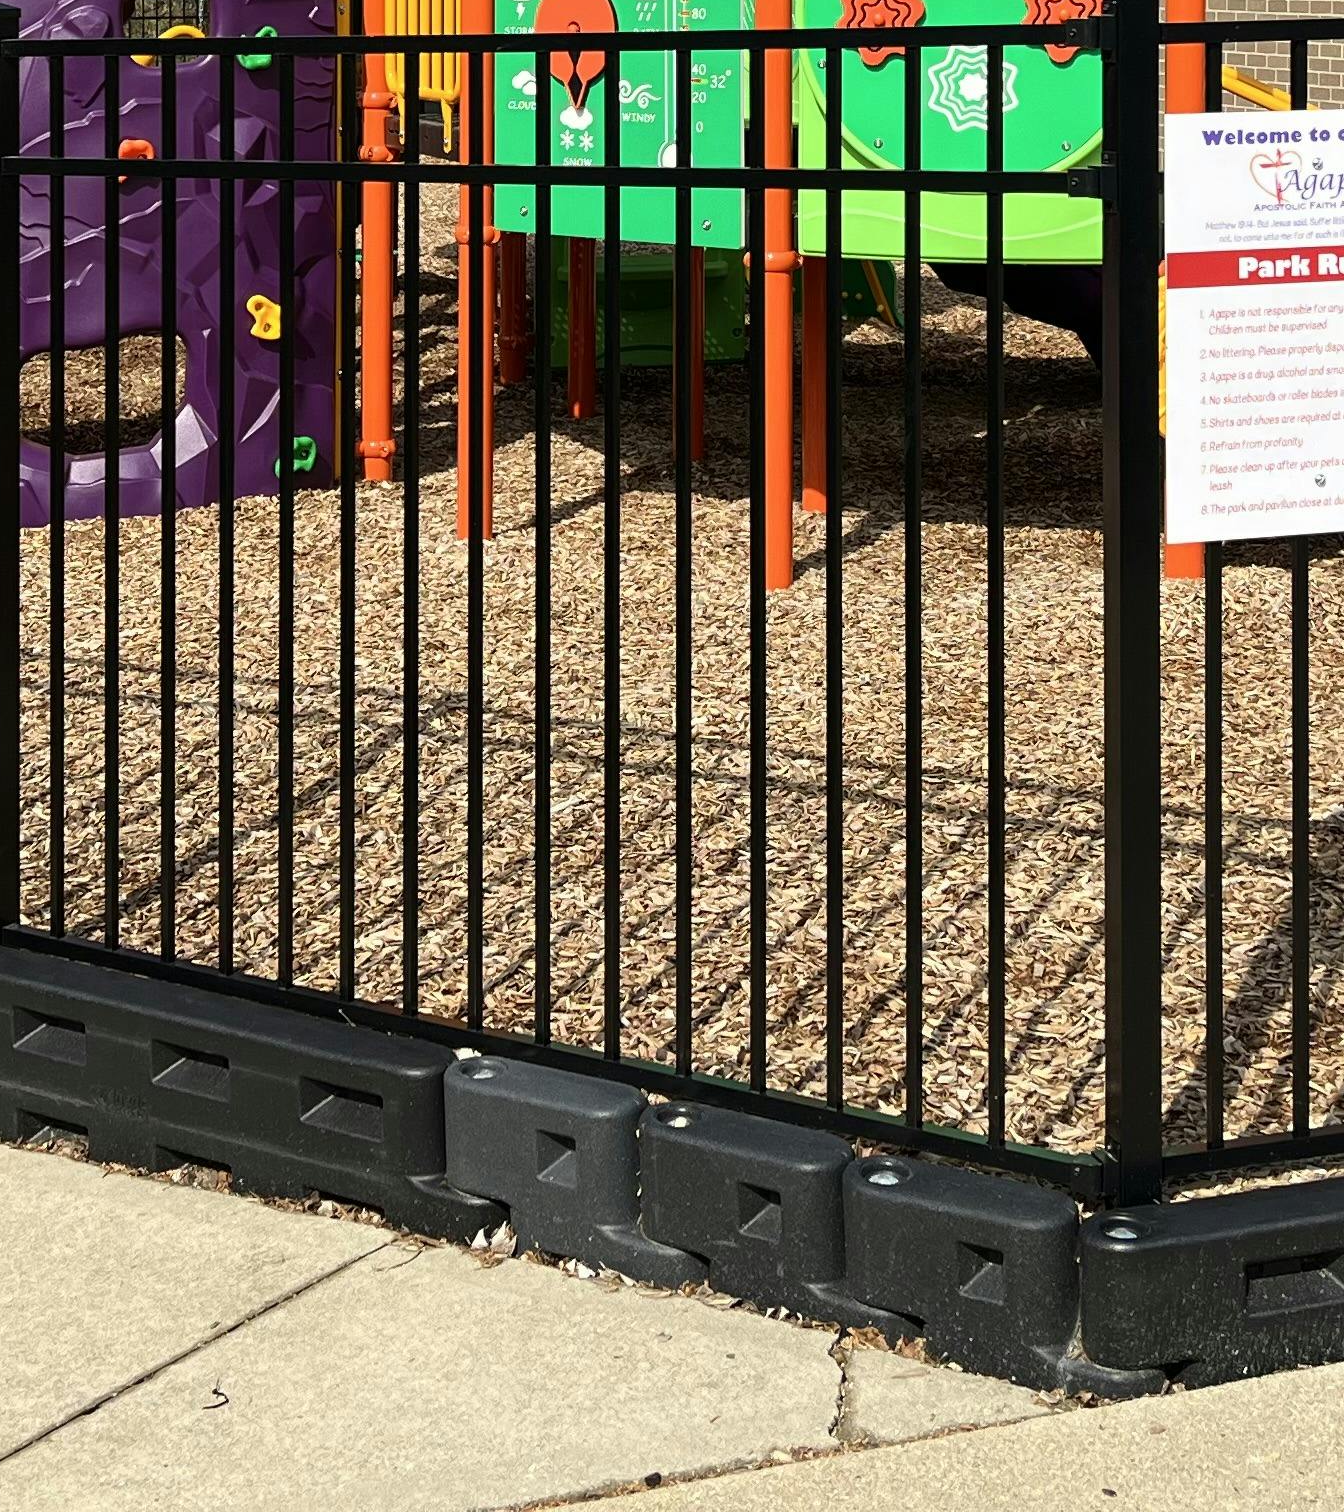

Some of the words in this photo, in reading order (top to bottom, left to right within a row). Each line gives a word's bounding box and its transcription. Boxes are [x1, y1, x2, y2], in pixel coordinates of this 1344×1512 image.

[691, 7, 707, 20] 80
[691, 91, 707, 104] 20
[621, 112, 656, 124] WINDY
[695, 120, 704, 133] 0
[1202, 128, 1302, 146] Welcome
[1310, 127, 1331, 142] to
[562, 157, 593, 166] SNOW
[1254, 201, 1306, 212] APOSTOLIC
[1309, 200, 1337, 210] FAITH
[1238, 254, 1310, 279] Park
[1209, 308, 1237, 321] Agape
[1247, 306, 1262, 317] not
[1264, 303, 1312, 318] responsible
[1313, 303, 1326, 313] for
[1328, 304, 1344, 314] any
[1209, 322, 1244, 336] Children
[1245, 323, 1266, 334] must
[1268, 322, 1280, 333] be
[1199, 349, 1208, 360] 2.
[1209, 348, 1221, 359] No
[1258, 345, 1287, 356] Please
[1288, 342, 1323, 357] properly
[1199, 372, 1208, 382] 3.
[1209, 370, 1237, 384] Agape
[1277, 366, 1307, 378] alcohol
[1309, 365, 1325, 376] and
[1209, 395, 1221, 405] No
[1223, 391, 1276, 405] skateboards
[1287, 389, 1310, 401] roller
[1311, 387, 1338, 399] blades
[1209, 417, 1235, 428] Shirts
[1236, 416, 1252, 427] and
[1254, 414, 1280, 425] shoes
[1281, 414, 1295, 424] are
[1297, 410, 1331, 425] required
[1332, 411, 1341, 421] at
[1209, 440, 1241, 452] Refrain
[1242, 439, 1263, 450] from
[1264, 436, 1304, 450] profanity
[1210, 463, 1239, 475] Please
[1240, 462, 1263, 472] clean
[1264, 462, 1276, 473] up
[1276, 460, 1299, 470] after
[1300, 459, 1320, 471] your
[1320, 458, 1340, 470] pets
[1209, 481, 1233, 492] leash
[1210, 503, 1226, 514] The
[1227, 501, 1247, 517] park
[1248, 500, 1265, 512] and
[1265, 497, 1298, 513] pavilion
[1299, 497, 1322, 509] close
[1323, 496, 1332, 506] at
